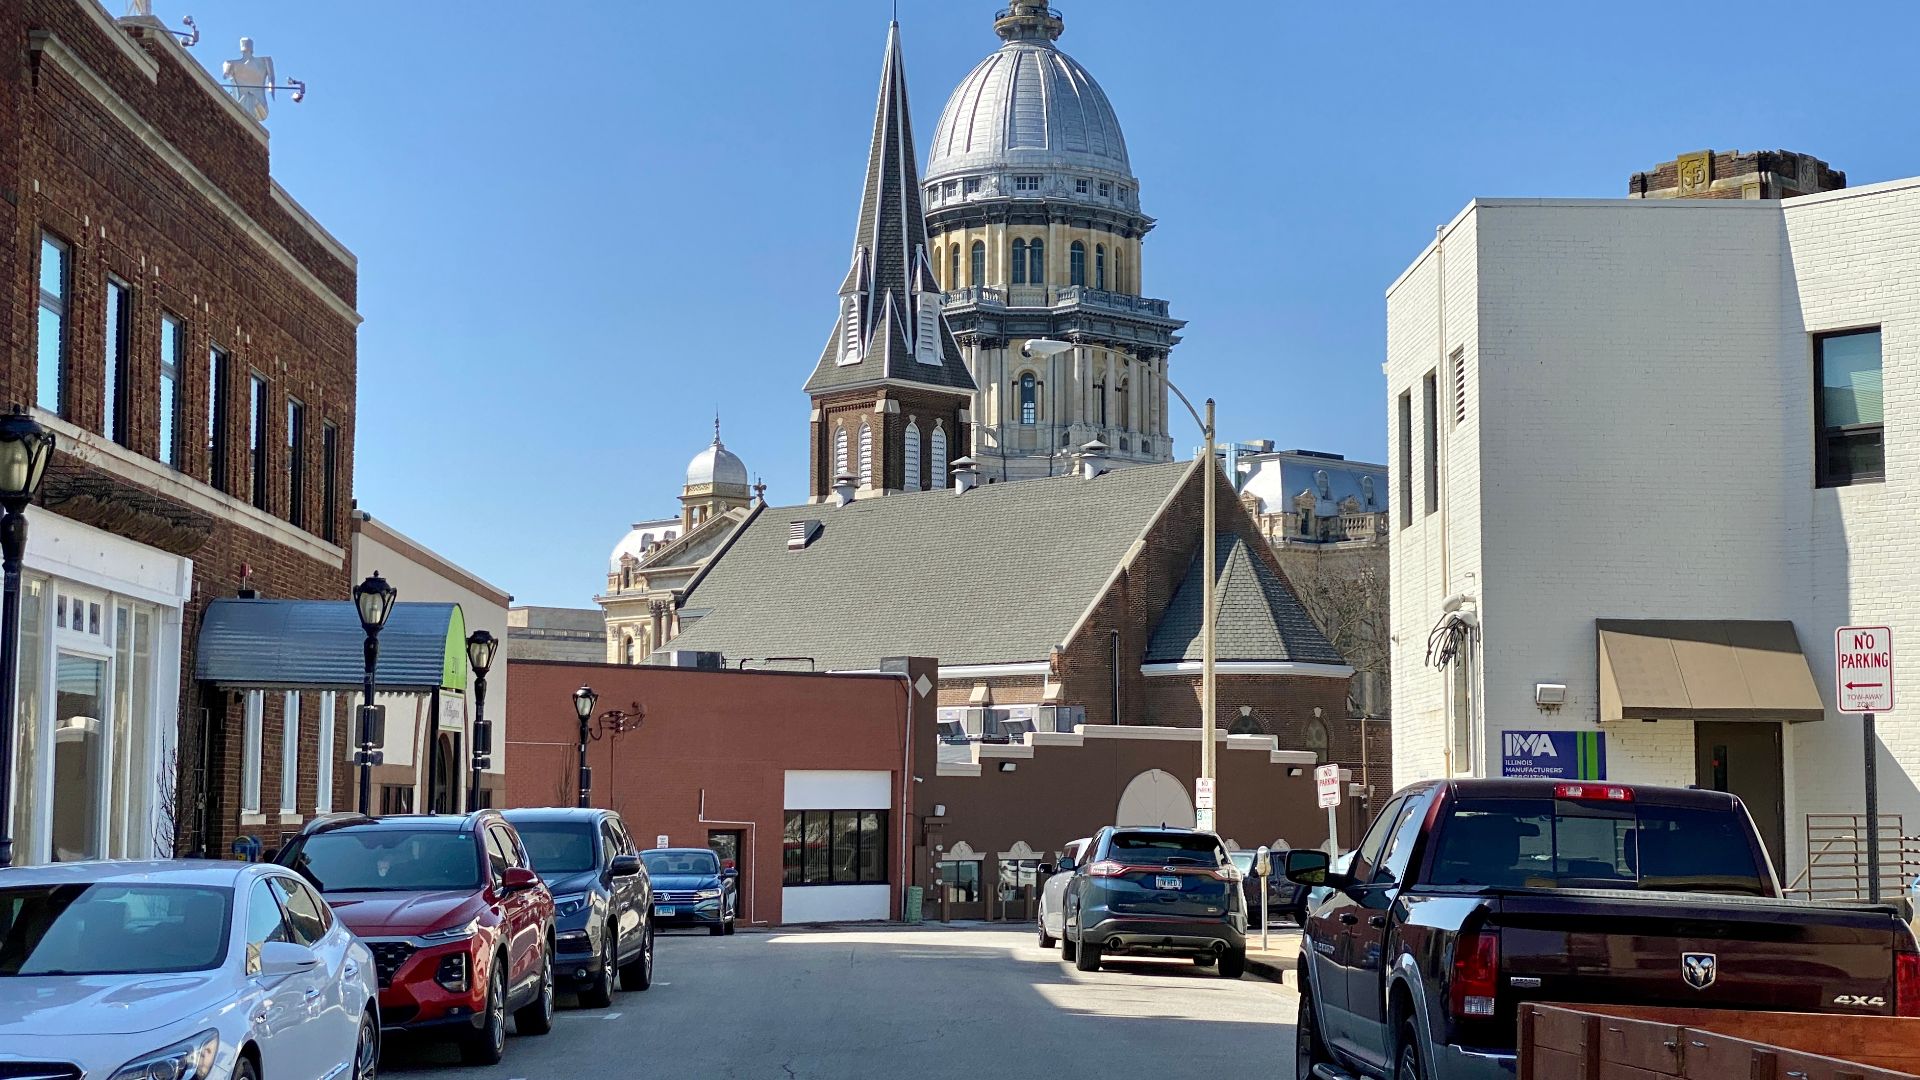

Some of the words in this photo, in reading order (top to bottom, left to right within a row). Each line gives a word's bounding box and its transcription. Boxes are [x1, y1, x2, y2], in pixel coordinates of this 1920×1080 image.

[1854, 634, 1874, 650] NO
[1841, 652, 1889, 669] PARKING
[1847, 693, 1884, 701] TOW-AWAY
[1504, 733, 1558, 757] IMA
